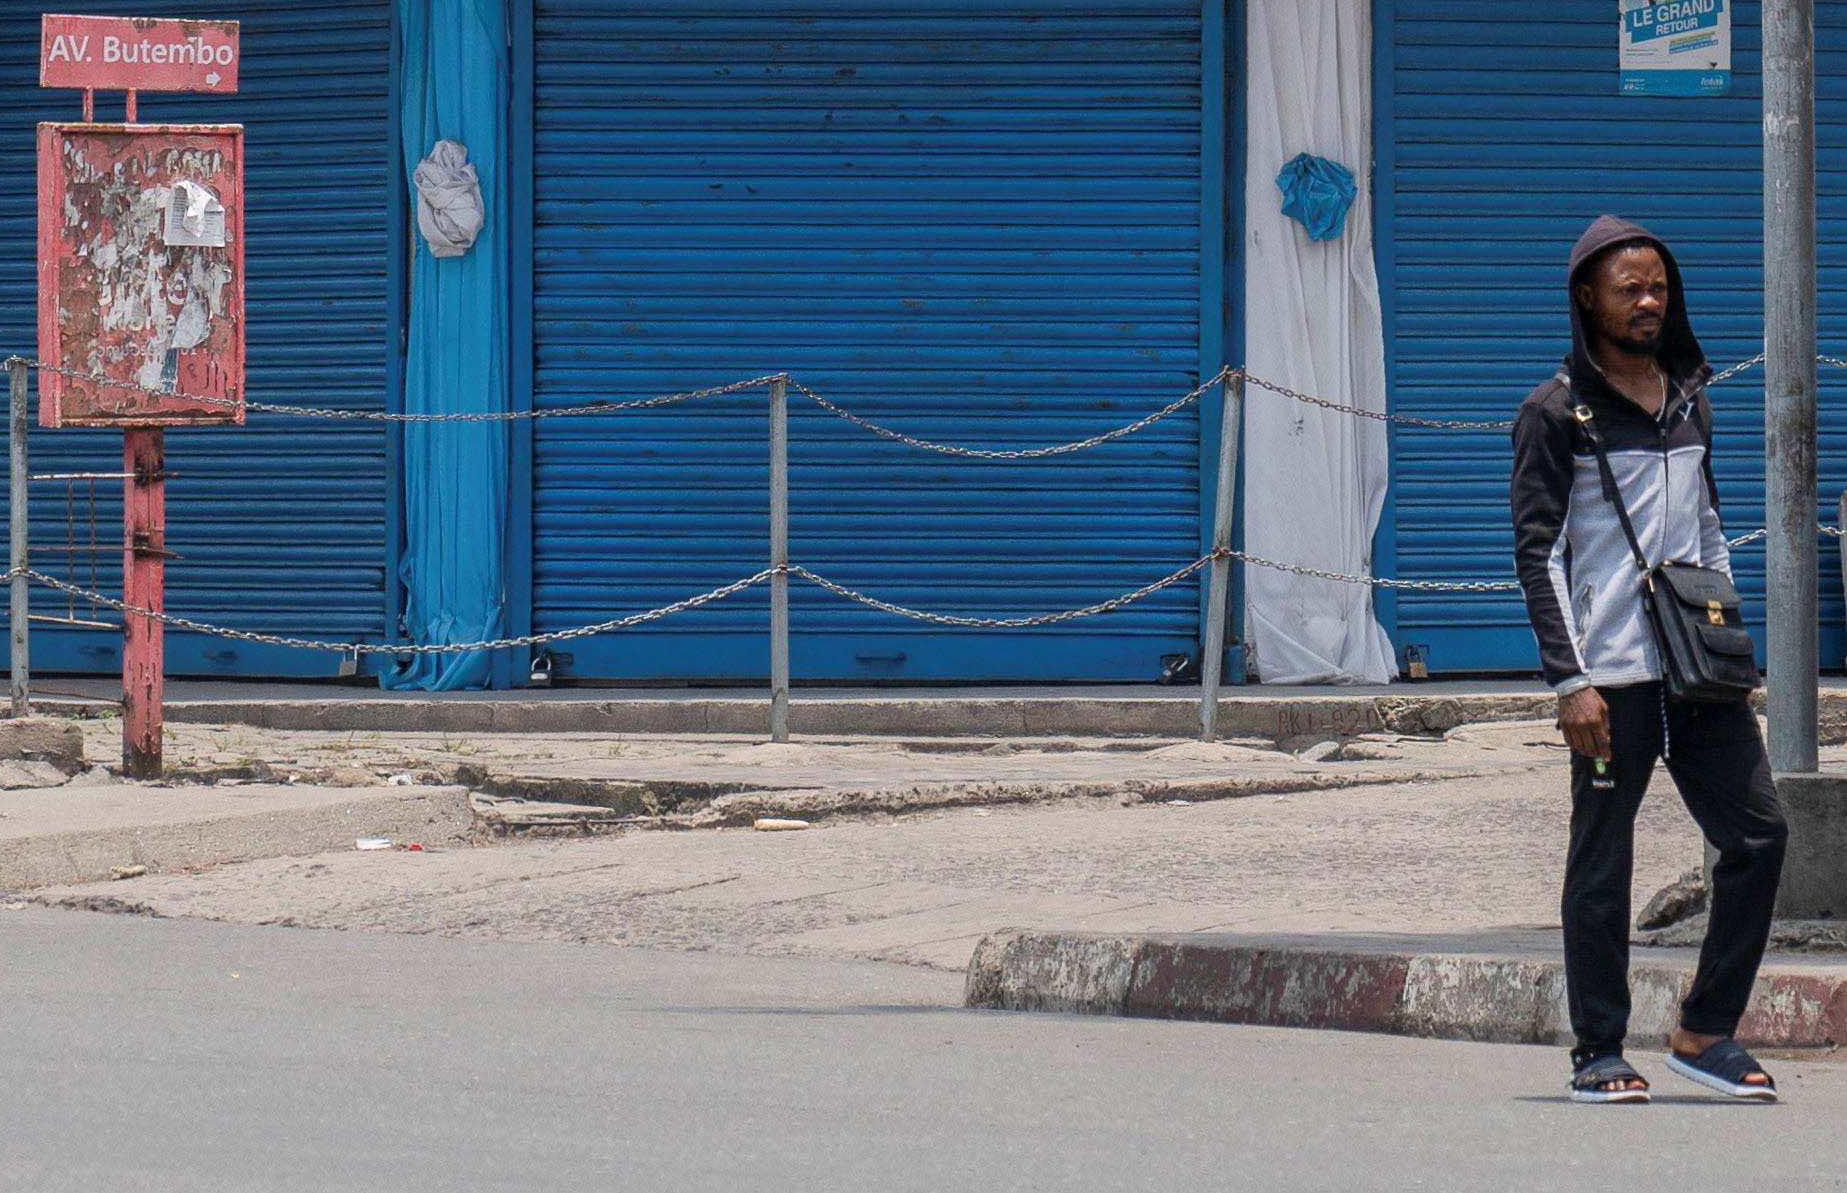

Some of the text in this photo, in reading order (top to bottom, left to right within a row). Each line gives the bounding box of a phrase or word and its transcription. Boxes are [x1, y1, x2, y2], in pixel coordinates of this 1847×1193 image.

[1633, 8, 1653, 28] LE
[1655, 17, 1699, 36] RETOUR
[48, 36, 234, 66] AV. Butembo
